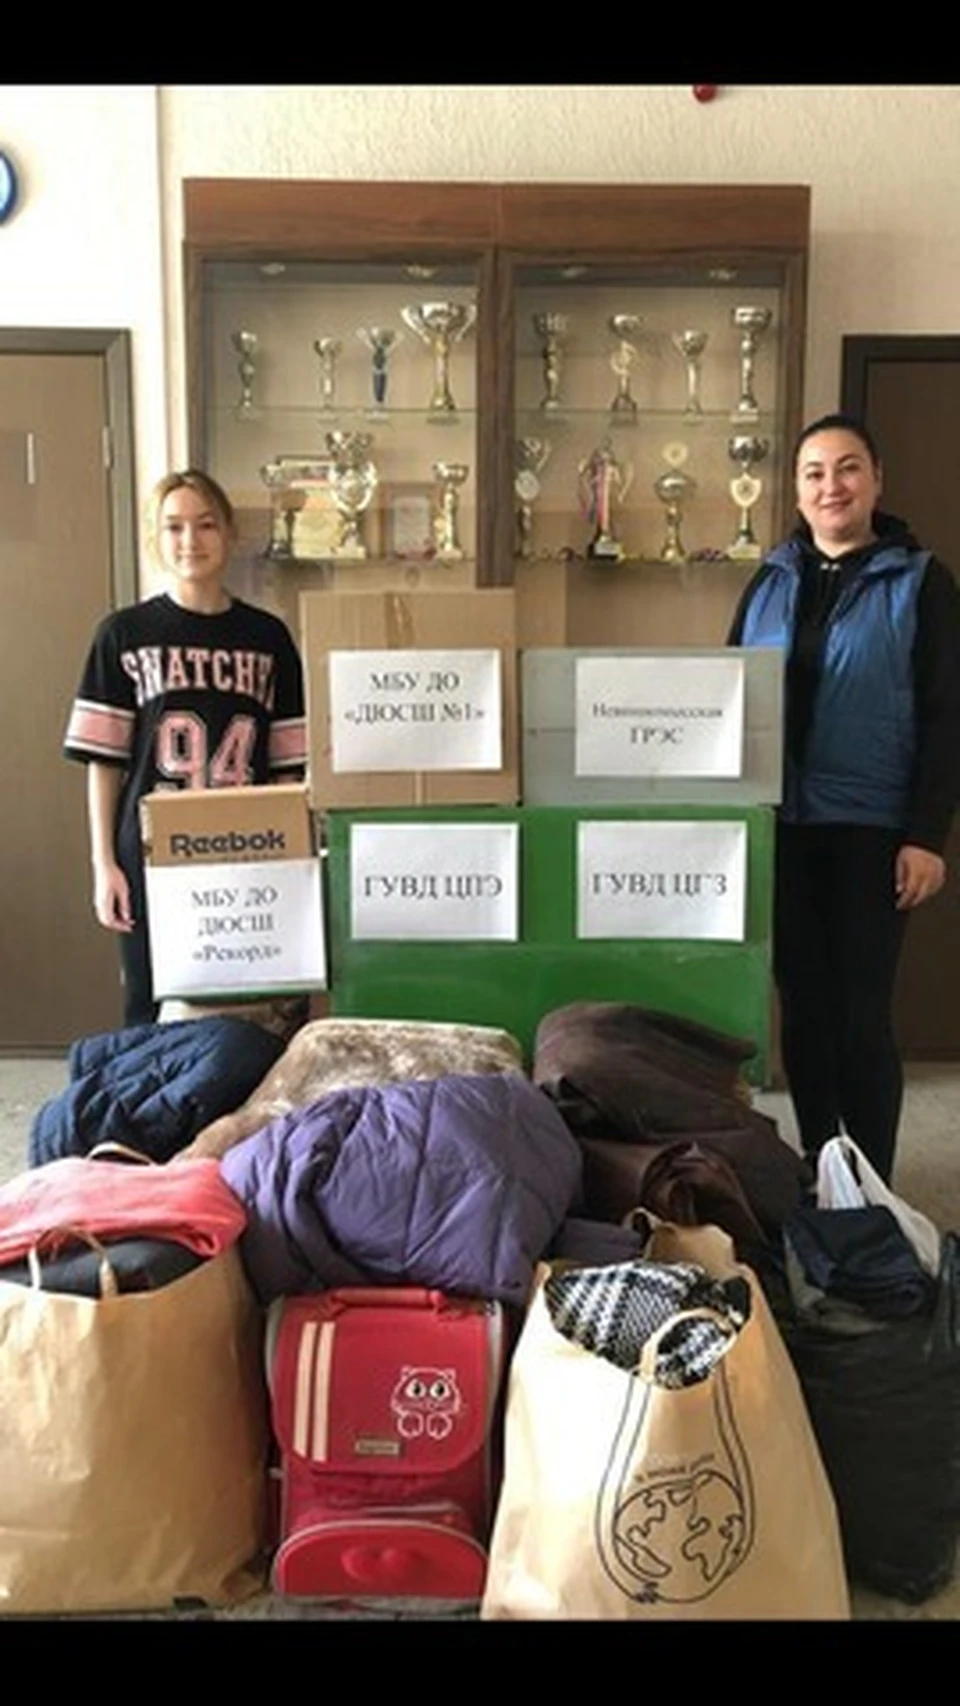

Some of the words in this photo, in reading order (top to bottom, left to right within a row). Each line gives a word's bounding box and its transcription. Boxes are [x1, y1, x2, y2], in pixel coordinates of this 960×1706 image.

[369, 671, 420, 692] МБУ
[425, 671, 460, 693] ДО
[344, 702, 435, 725] «ДЮСШ
[440, 702, 485, 723] №1»
[155, 710, 258, 789] 94
[169, 828, 286, 858] Reebok
[190, 886, 240, 908] МБУ
[244, 885, 279, 907] ДО
[363, 874, 437, 901] ГУВД
[445, 874, 504, 901] ЦПЭ
[592, 872, 665, 899] ГУВД
[673, 871, 729, 898] ЦГЗ
[197, 914, 275, 937] ДЮСШ
[192, 944, 283, 964] «Рекорд»
